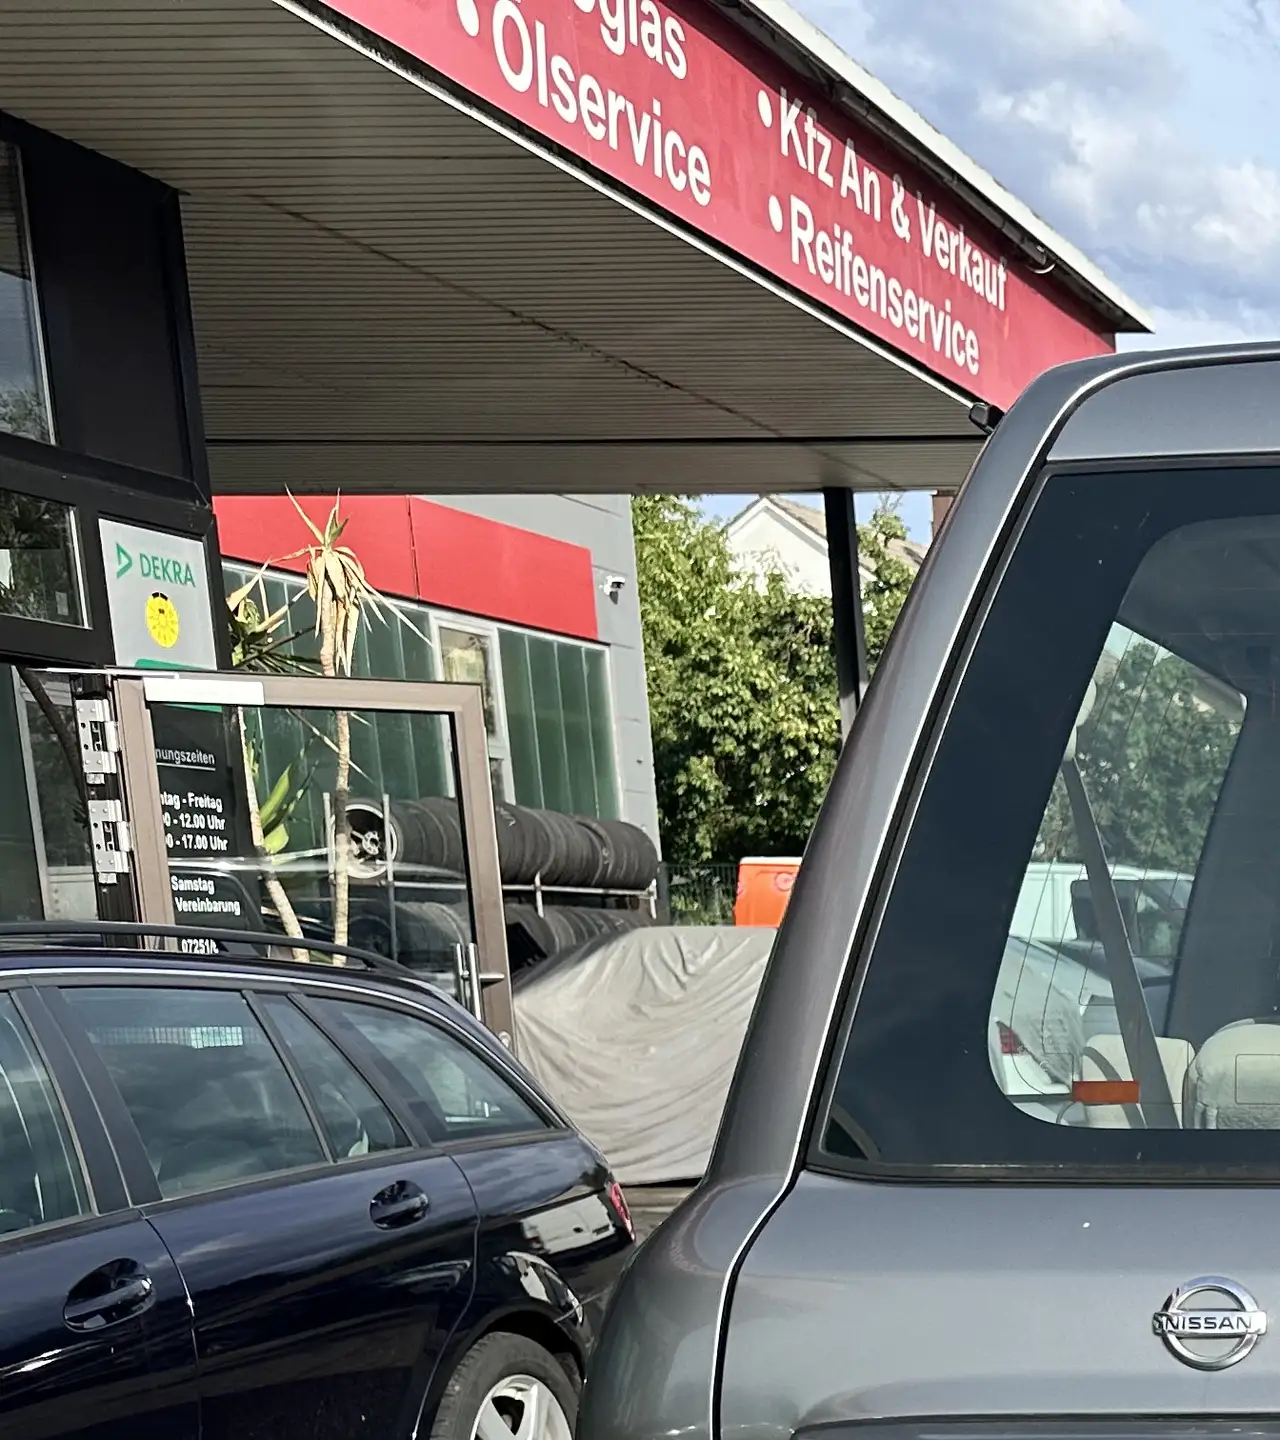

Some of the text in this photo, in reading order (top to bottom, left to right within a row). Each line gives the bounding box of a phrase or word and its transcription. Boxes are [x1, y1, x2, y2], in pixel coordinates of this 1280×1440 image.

[780, 87, 1007, 311] Kfz An & Verkauf
[790, 194, 980, 376] Reifenservice
[139, 553, 196, 588] DEKRA
[187, 791, 223, 813] Freitag
[179, 813, 206, 829] 12.00
[207, 815, 226, 830] Uhr
[181, 834, 208, 850] 17.00
[209, 835, 228, 851] Uhr
[171, 875, 215, 895] Samstag
[174, 897, 241, 916] Vereinbarung
[1164, 1316, 1252, 1330] NISSAN
